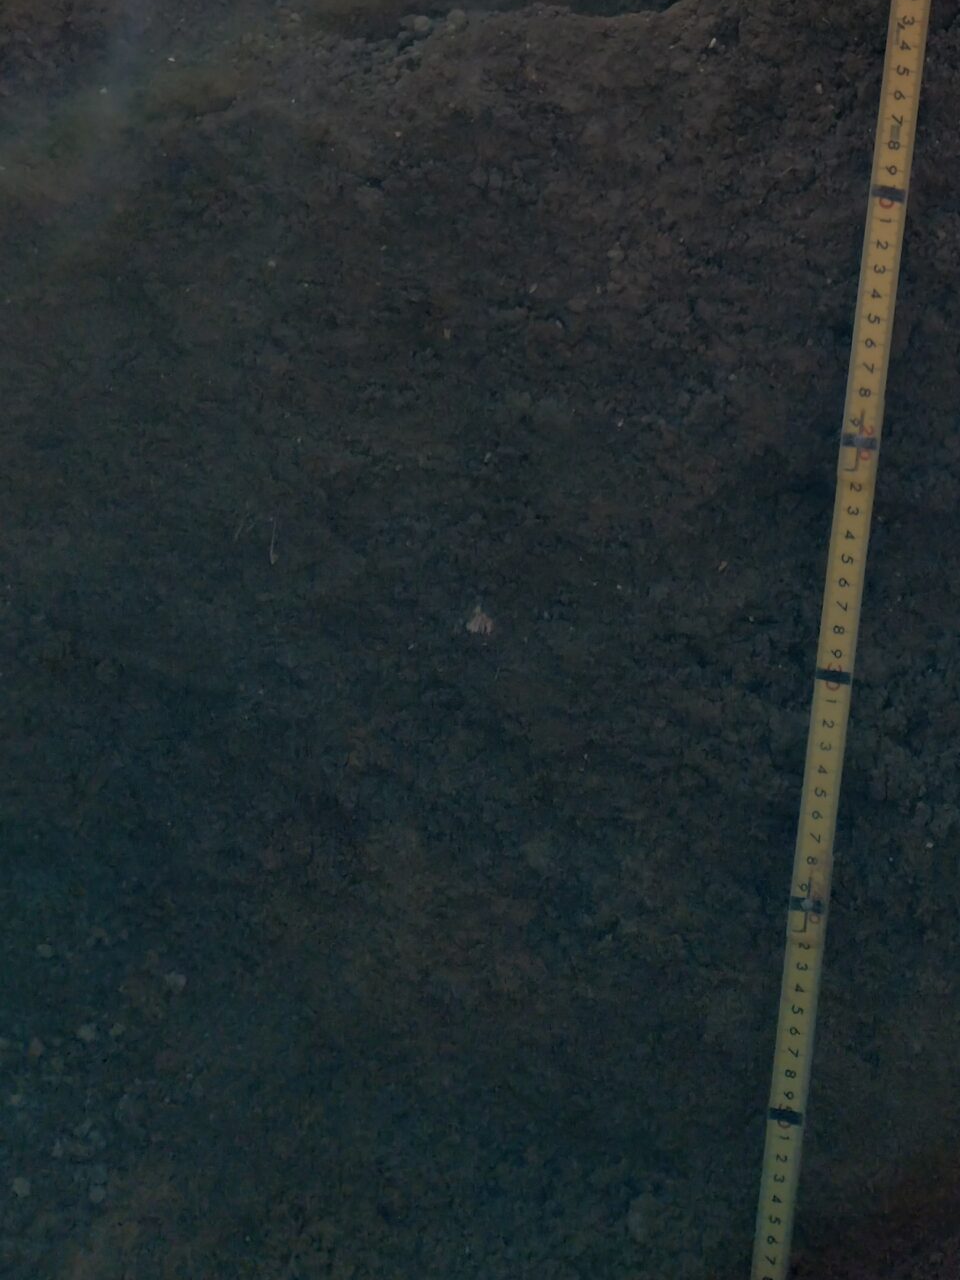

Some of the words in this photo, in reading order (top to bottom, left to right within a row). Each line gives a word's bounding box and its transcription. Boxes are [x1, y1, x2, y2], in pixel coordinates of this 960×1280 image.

[901, 16, 915, 26] 3
[900, 40, 911, 50] 4
[896, 65, 910, 76] 5
[893, 90, 906, 100] 6
[891, 114, 904, 126] 7
[888, 140, 900, 151] 8
[885, 165, 898, 175] 9
[876, 240, 889, 250] 2
[874, 264, 886, 274] 3
[871, 289, 882, 299] 4
[867, 313, 880, 324] 5
[865, 338, 876, 348] 6
[863, 362, 874, 374] 7
[859, 387, 871, 397] 8
[850, 482, 862, 492] 2
[847, 506, 859, 516] 3
[845, 530, 855, 539] 4
[841, 554, 854, 564] 5
[838, 578, 850, 587] 6
[836, 601, 848, 611] 7
[833, 625, 845, 634] 8
[831, 649, 842, 659] 9
[822, 719, 834, 728] 2
[820, 742, 832, 751] 3
[818, 765, 828, 774] 4
[814, 787, 826, 797] 5
[812, 810, 823, 820] 6
[810, 833, 821, 843] 7
[807, 856, 818, 865] 8
[798, 942, 811, 950] 2
[796, 962, 808, 971] 3
[795, 984, 804, 992] 4
[792, 1005, 804, 1014] 5
[790, 1027, 800, 1035] 6
[788, 1048, 799, 1058] 7
[785, 1069, 796, 1079] 8
[784, 1091, 794, 1100] 9
[776, 1154, 787, 1163] 2
[774, 1174, 785, 1183] 3
[772, 1195, 782, 1203] 4
[768, 1215, 781, 1225] 5
[767, 1235, 778, 1244] 6
[765, 1256, 776, 1265] 7
